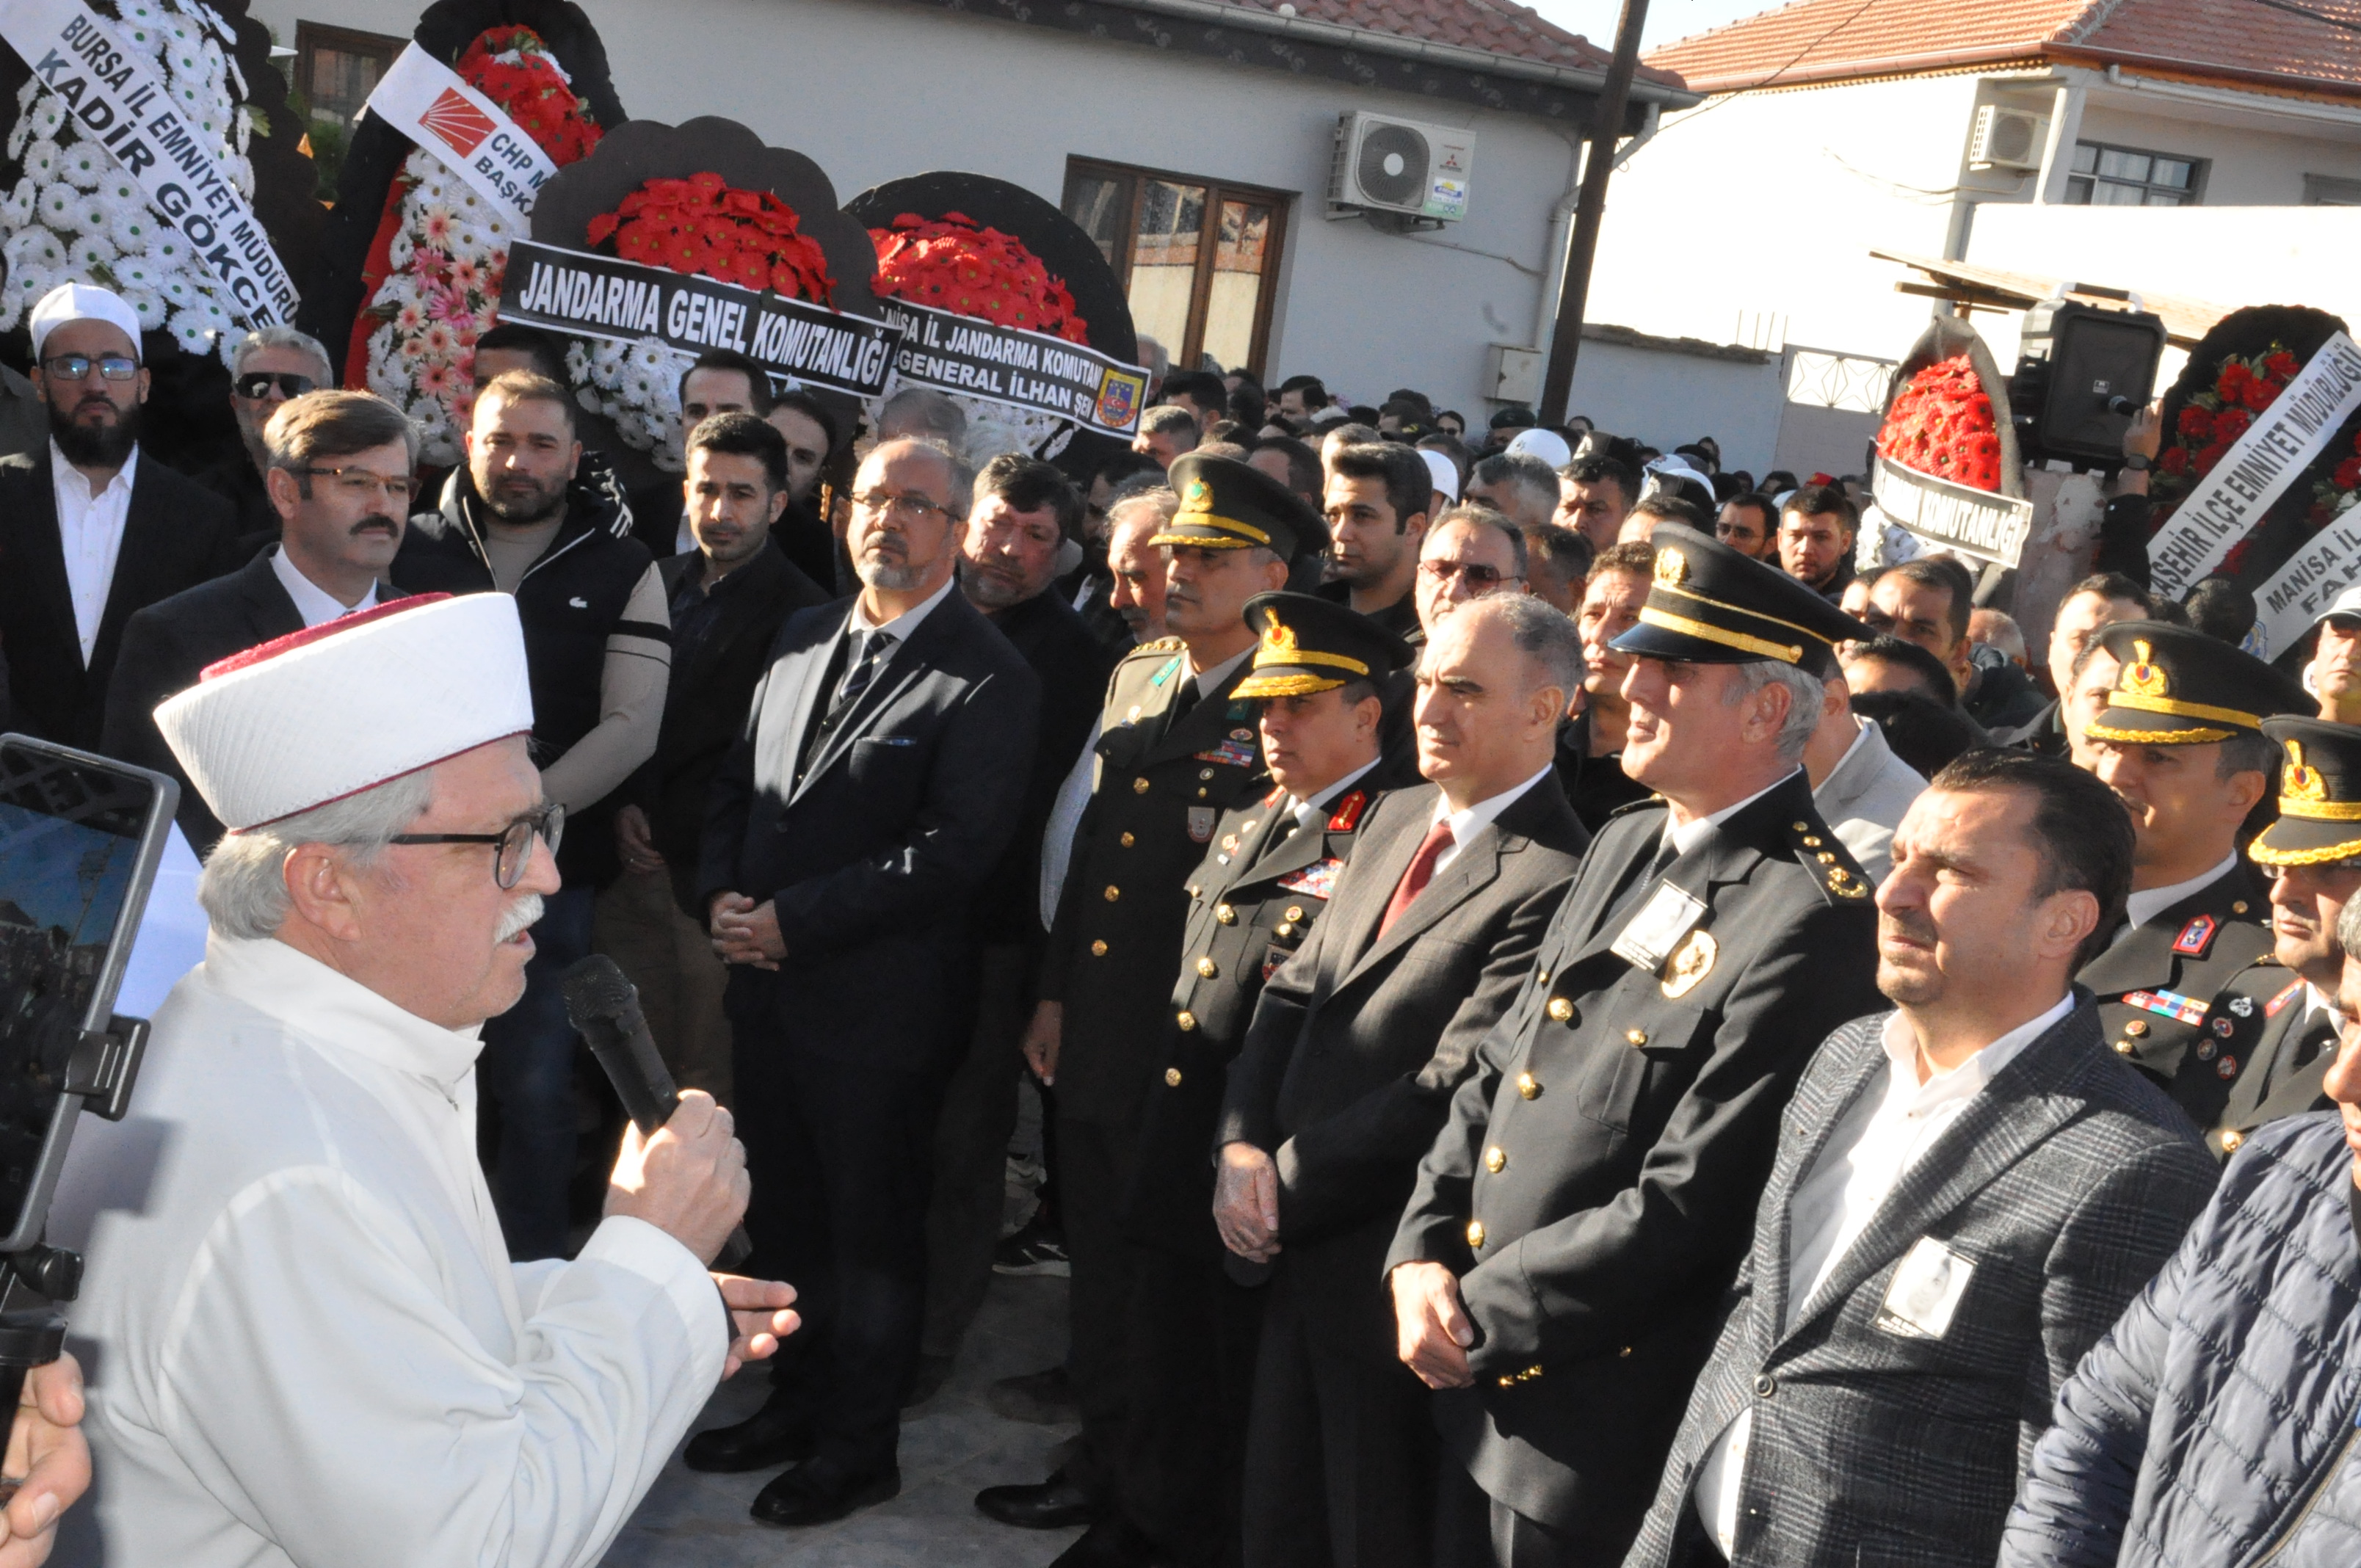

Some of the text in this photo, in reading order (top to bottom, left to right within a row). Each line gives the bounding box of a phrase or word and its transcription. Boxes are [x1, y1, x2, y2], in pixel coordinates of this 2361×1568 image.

[35, 48, 156, 178] KADİR
[61, 14, 135, 93] BURSA
[123, 81, 156, 119] İL
[147, 111, 240, 219] EMNİYET
[475, 156, 532, 217] BAŞK
[491, 133, 533, 170] CHP
[521, 261, 890, 387] JANDARMA GENEL KOMUTANLIĞI
[923, 314, 940, 349] İL
[945, 325, 1038, 371] JANDARMA
[1042, 348, 1103, 391] KOMUTANI
[893, 349, 1002, 393] GENERAL
[1009, 371, 1070, 410] İLHAN
[2185, 489, 2246, 539] İLÇE
[2224, 421, 2305, 502] EMNİYET
[1919, 489, 2023, 554] KOMUTANLIĞI
[2266, 545, 2342, 614] MANİSA
